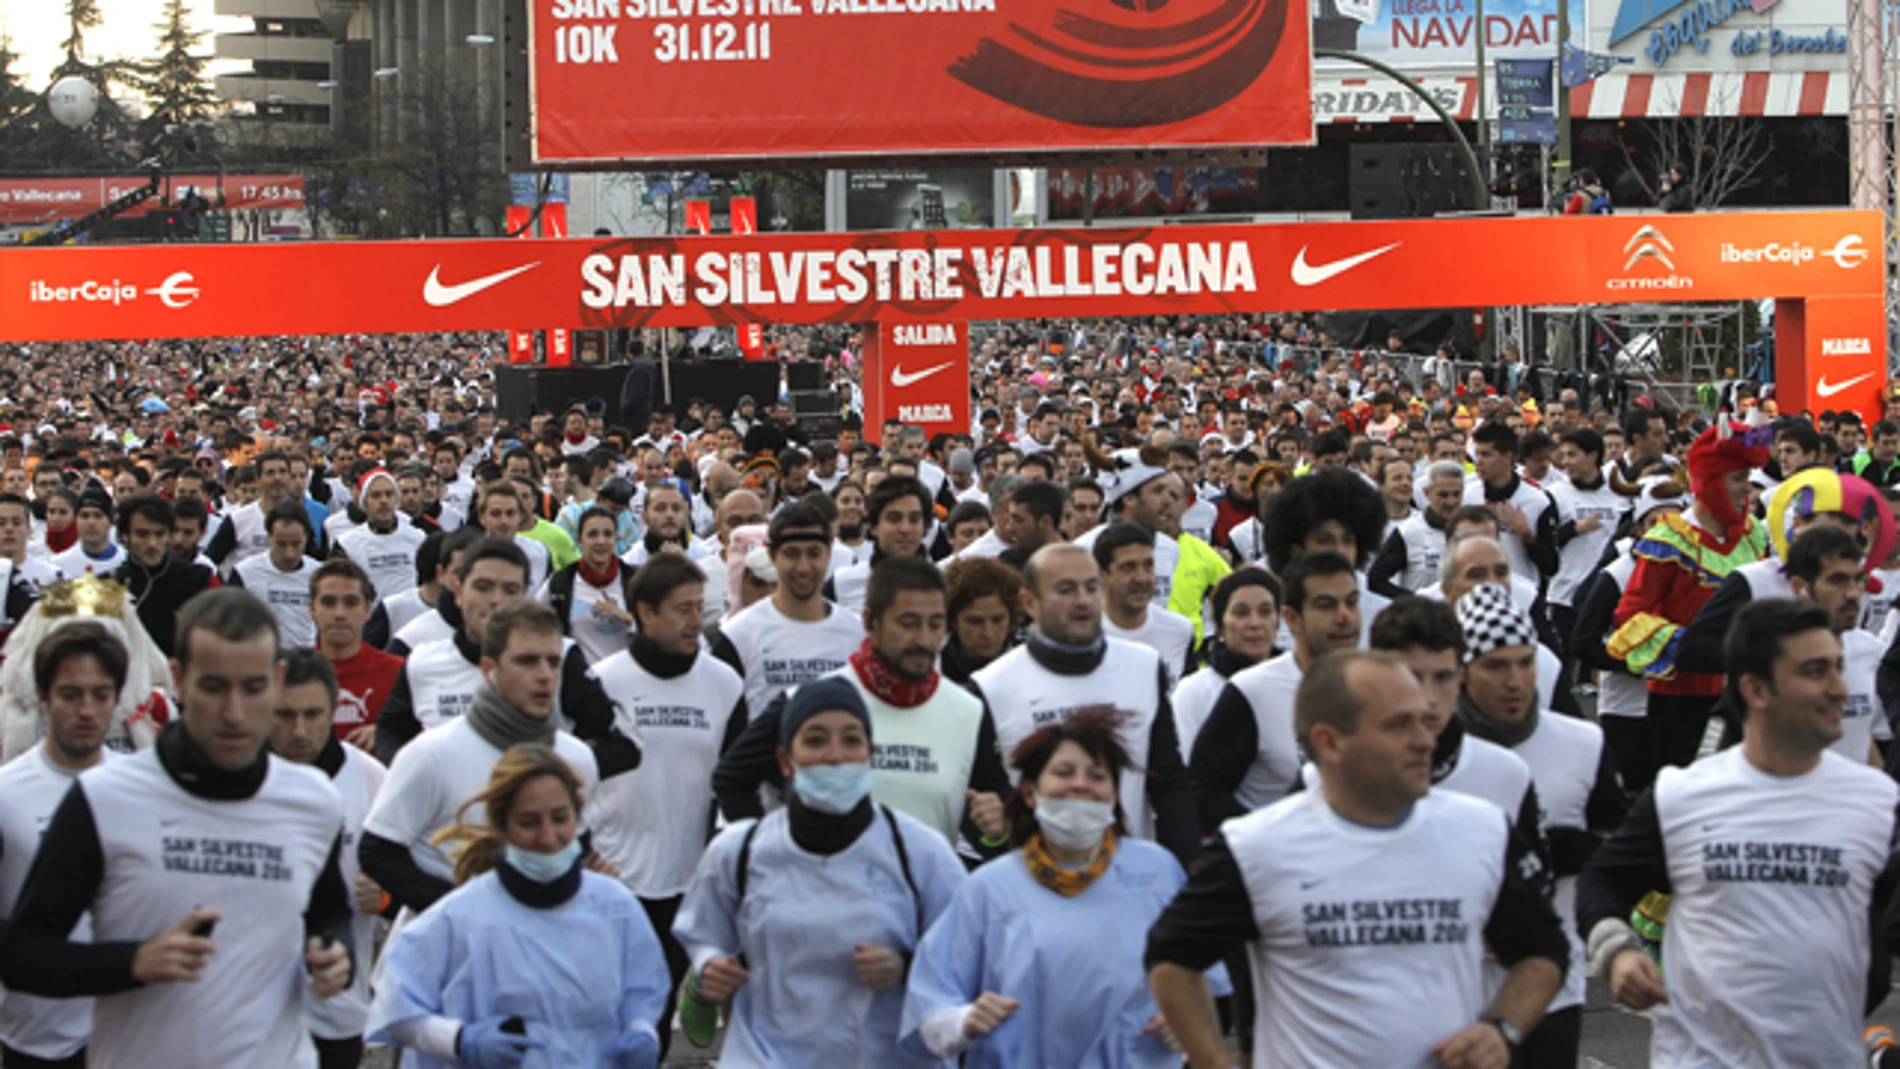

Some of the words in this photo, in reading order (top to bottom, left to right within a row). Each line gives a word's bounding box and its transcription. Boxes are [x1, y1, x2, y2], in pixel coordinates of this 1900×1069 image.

[555, 24, 619, 64] 10K
[654, 22, 771, 62] 31.12.11
[1392, 14, 1571, 48] NAVDAD
[1315, 87, 1458, 114] RIDAY'S
[1720, 241, 1814, 266] iberCaja
[580, 252, 686, 308] SAN
[694, 248, 965, 305] SILVESTRE
[970, 240, 1257, 299] VALLECANA
[29, 278, 138, 306] iberCaja
[892, 323, 958, 346] SALIDA
[1821, 337, 1872, 356] MARCA
[897, 402, 954, 423] MARCA
[162, 837, 195, 852] SAN
[201, 838, 284, 861] SILVESTRE
[1702, 842, 1741, 863] SAN
[1743, 841, 1845, 868] SILVESTRE
[163, 857, 256, 878] VALLECANA
[1703, 863, 1811, 885] VALLECANA
[1302, 902, 1347, 925] SAN
[1351, 897, 1463, 922] SILVESTRE
[1304, 922, 1427, 949] VALLECANA
